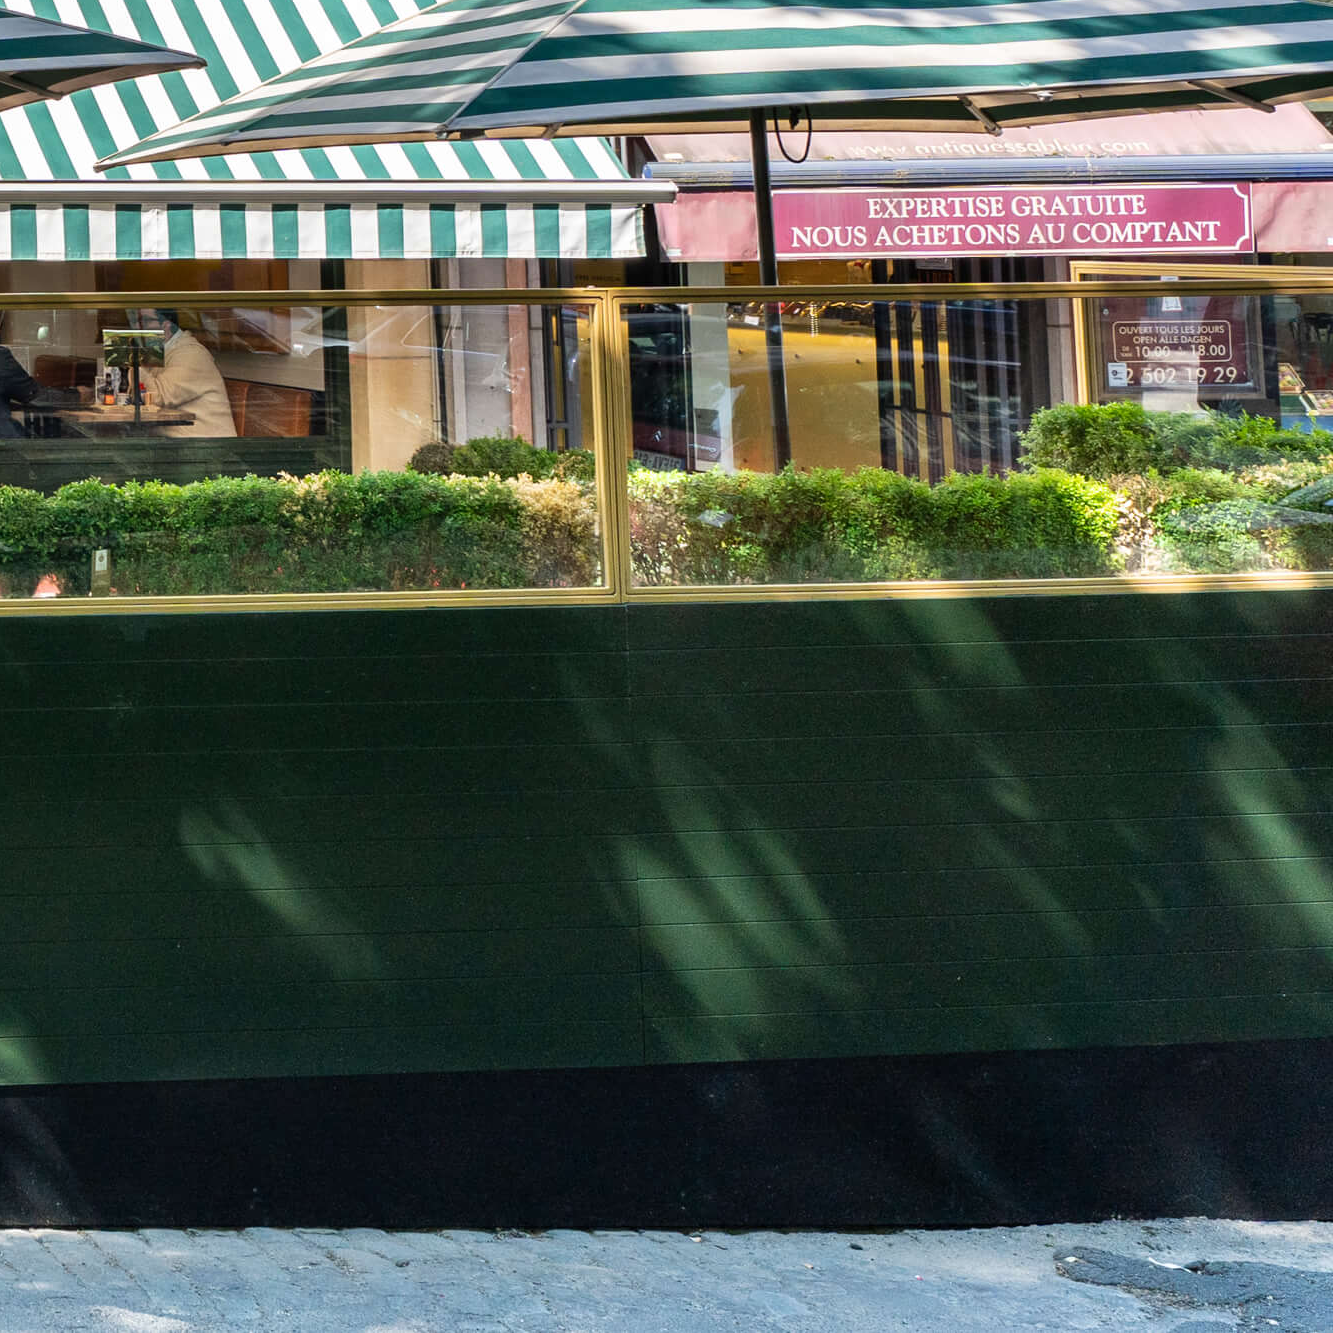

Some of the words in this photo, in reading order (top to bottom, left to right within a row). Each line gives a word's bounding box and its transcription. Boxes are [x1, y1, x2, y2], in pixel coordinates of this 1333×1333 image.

[867, 197, 1006, 218] EXPERTISE
[1010, 195, 1147, 217] GRATUITE
[791, 226, 867, 248] NOUS
[873, 223, 1020, 247] ACHETONS
[1028, 224, 1070, 244] AU
[1073, 220, 1221, 245] COMPTANT
[1155, 326, 1179, 334] TOUS
[1180, 326, 1196, 334] LES
[1197, 326, 1224, 334] JOURS
[1133, 336, 1157, 344] OPEN
[1159, 336, 1179, 344] ALLE
[1181, 336, 1211, 344] DAGEN
[1135, 346, 1170, 357] 10.00
[1191, 345, 1226, 356] 18.00
[1141, 368, 1176, 384] 502
[1189, 368, 1207, 383] 19
[1213, 367, 1237, 383] 29
